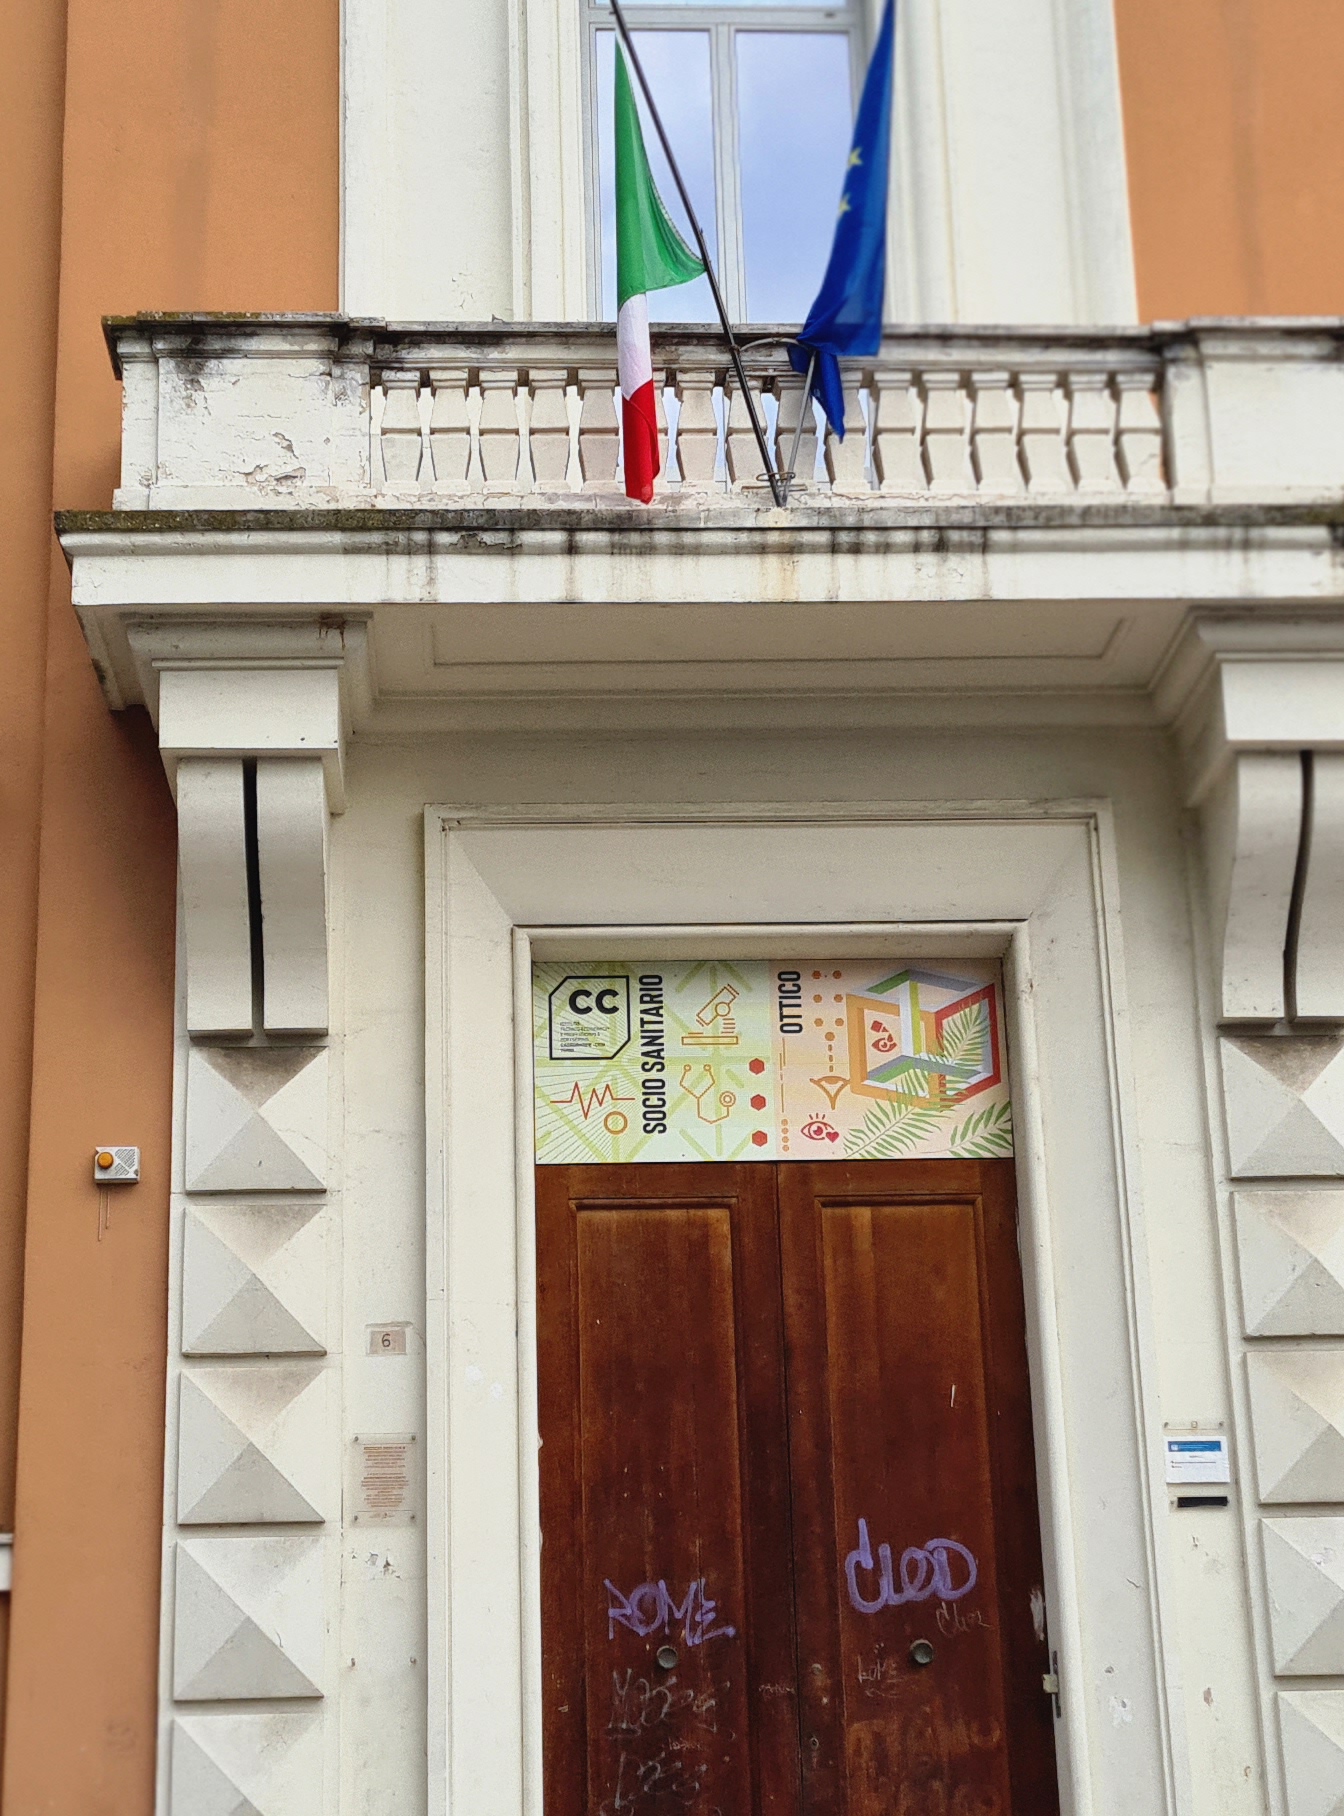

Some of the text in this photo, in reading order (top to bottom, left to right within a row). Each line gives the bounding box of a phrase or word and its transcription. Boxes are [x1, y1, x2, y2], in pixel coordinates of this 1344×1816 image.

[568, 988, 620, 1015] CC
[777, 970, 803, 1034] OTTICO
[639, 974, 667, 1134] SOCIO SANITARIO
[381, 1333, 391, 1348] 6
